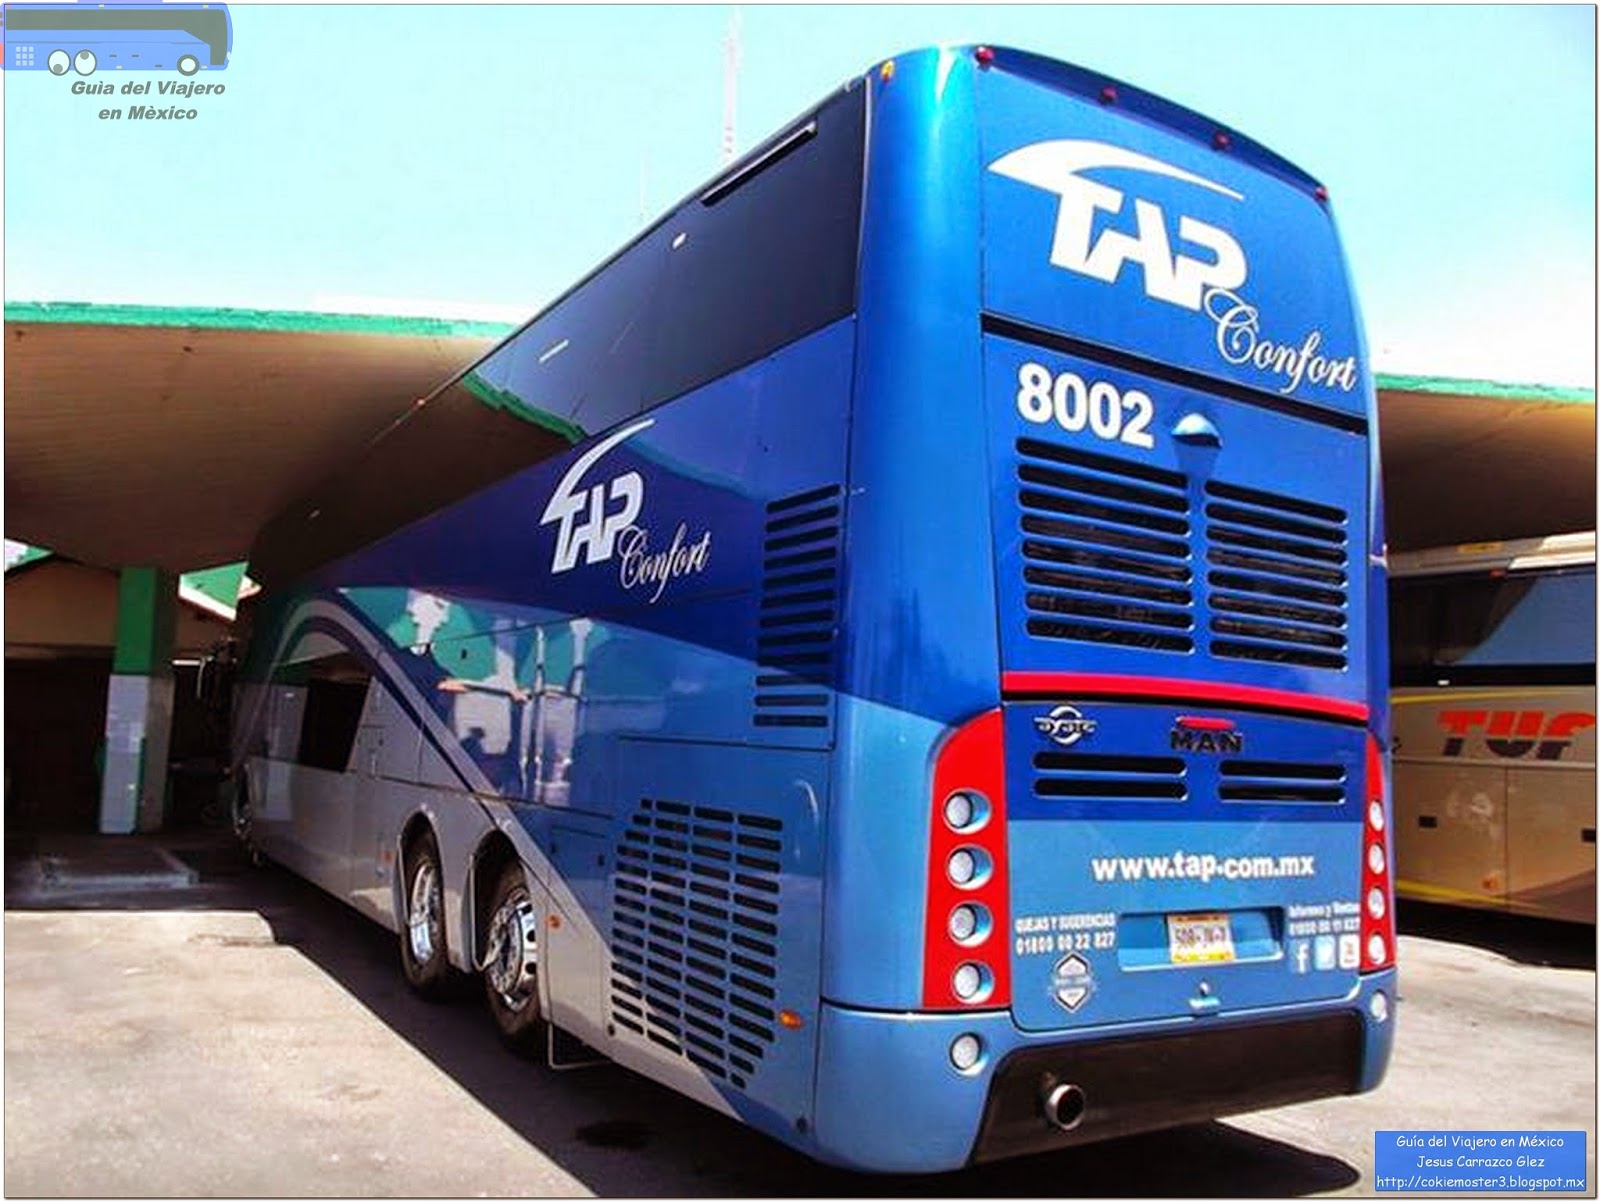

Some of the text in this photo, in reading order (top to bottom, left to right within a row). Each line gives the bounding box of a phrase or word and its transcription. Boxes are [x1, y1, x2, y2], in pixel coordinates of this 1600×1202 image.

[1045, 160, 1248, 311] TAP
[1203, 286, 1358, 394] Confort
[1016, 362, 1155, 449] 8002
[540, 462, 644, 574] TAP
[617, 523, 711, 603] Confort
[1170, 729, 1244, 754] MAN
